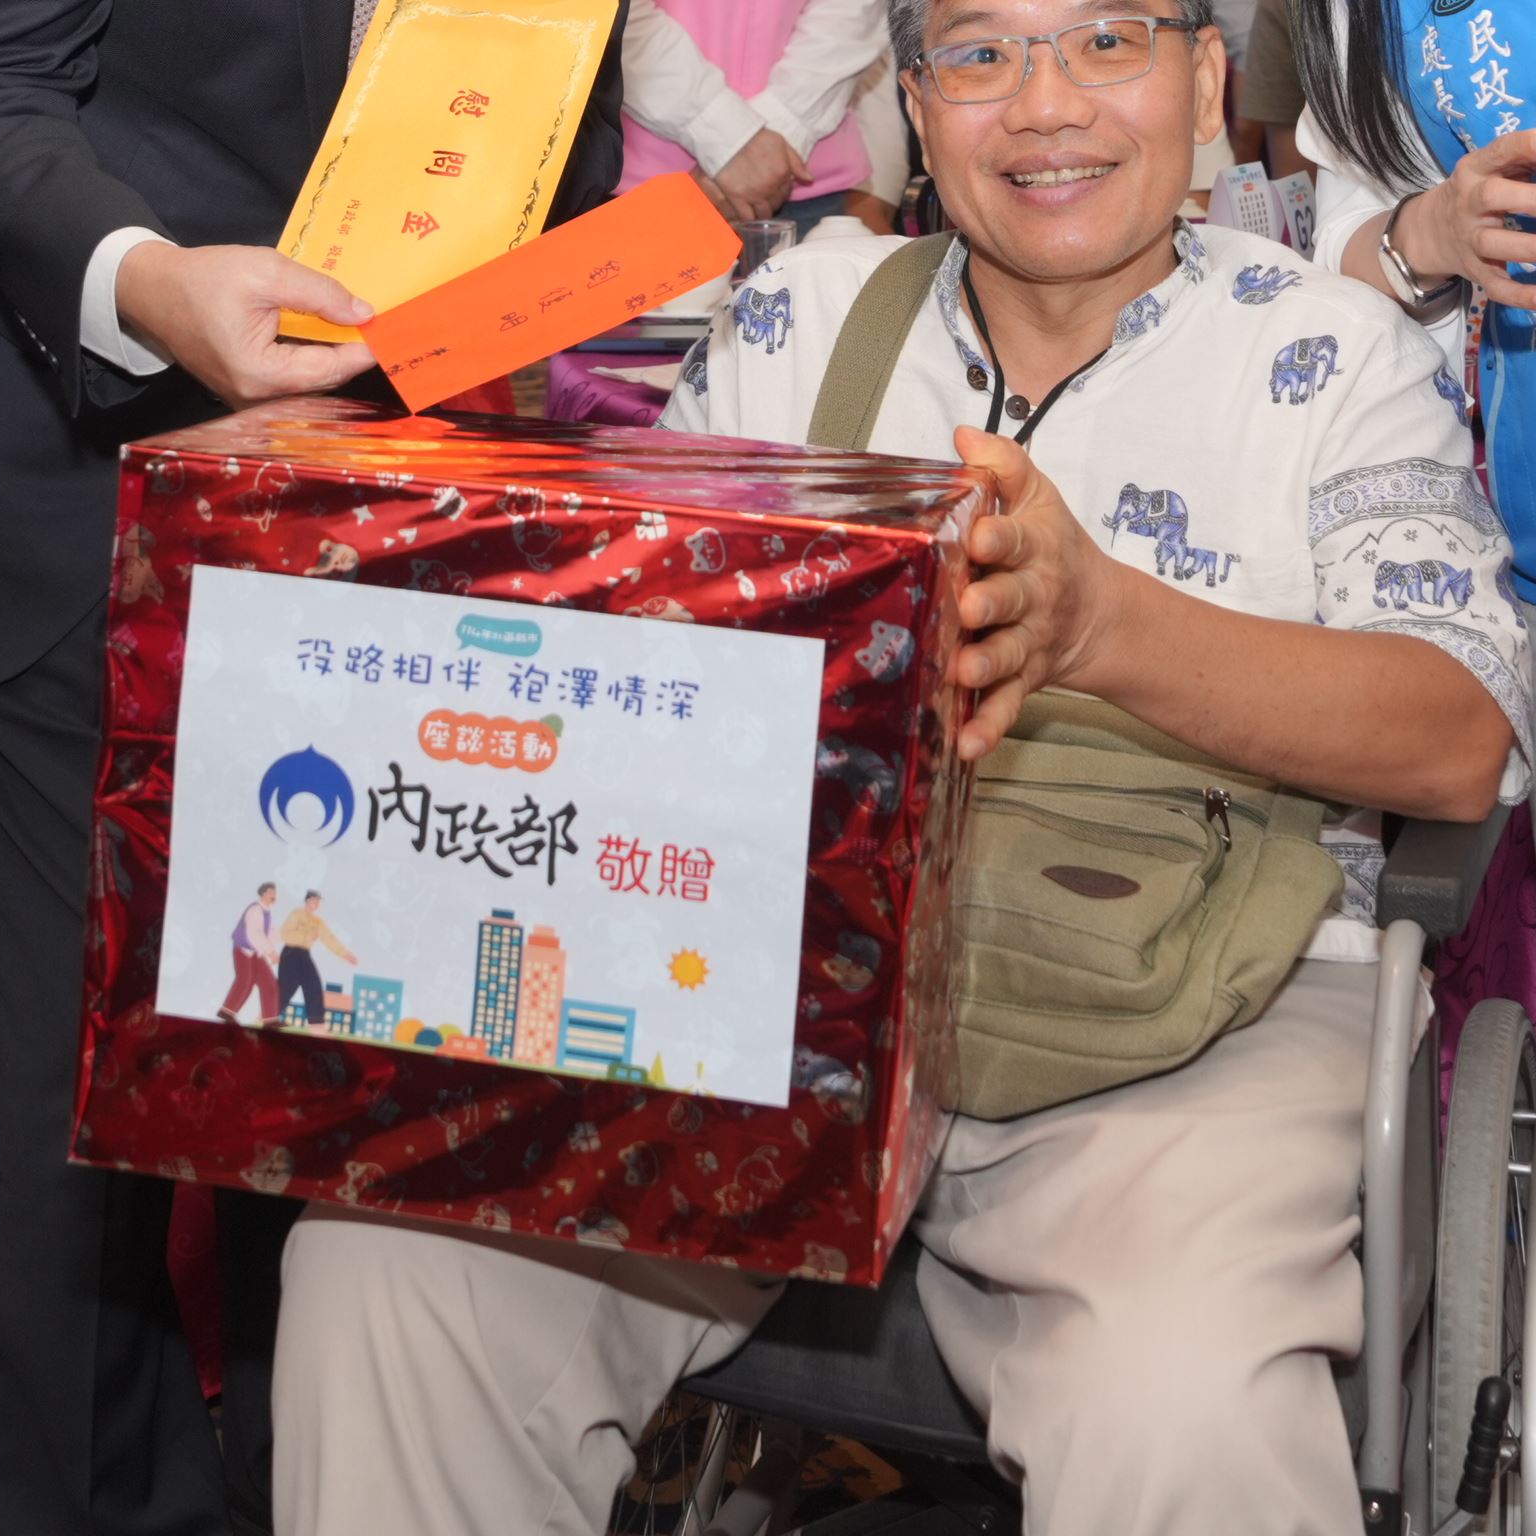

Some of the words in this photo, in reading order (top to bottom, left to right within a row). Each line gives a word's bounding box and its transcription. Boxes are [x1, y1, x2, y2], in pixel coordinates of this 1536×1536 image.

[401, 88, 490, 240] 慰問金
[296, 637, 482, 693] 役路相伴
[508, 661, 701, 721] 袍澤情深
[423, 718, 551, 760] 座談活動
[367, 761, 579, 886] 內政部
[595, 834, 716, 904] 敬贈
